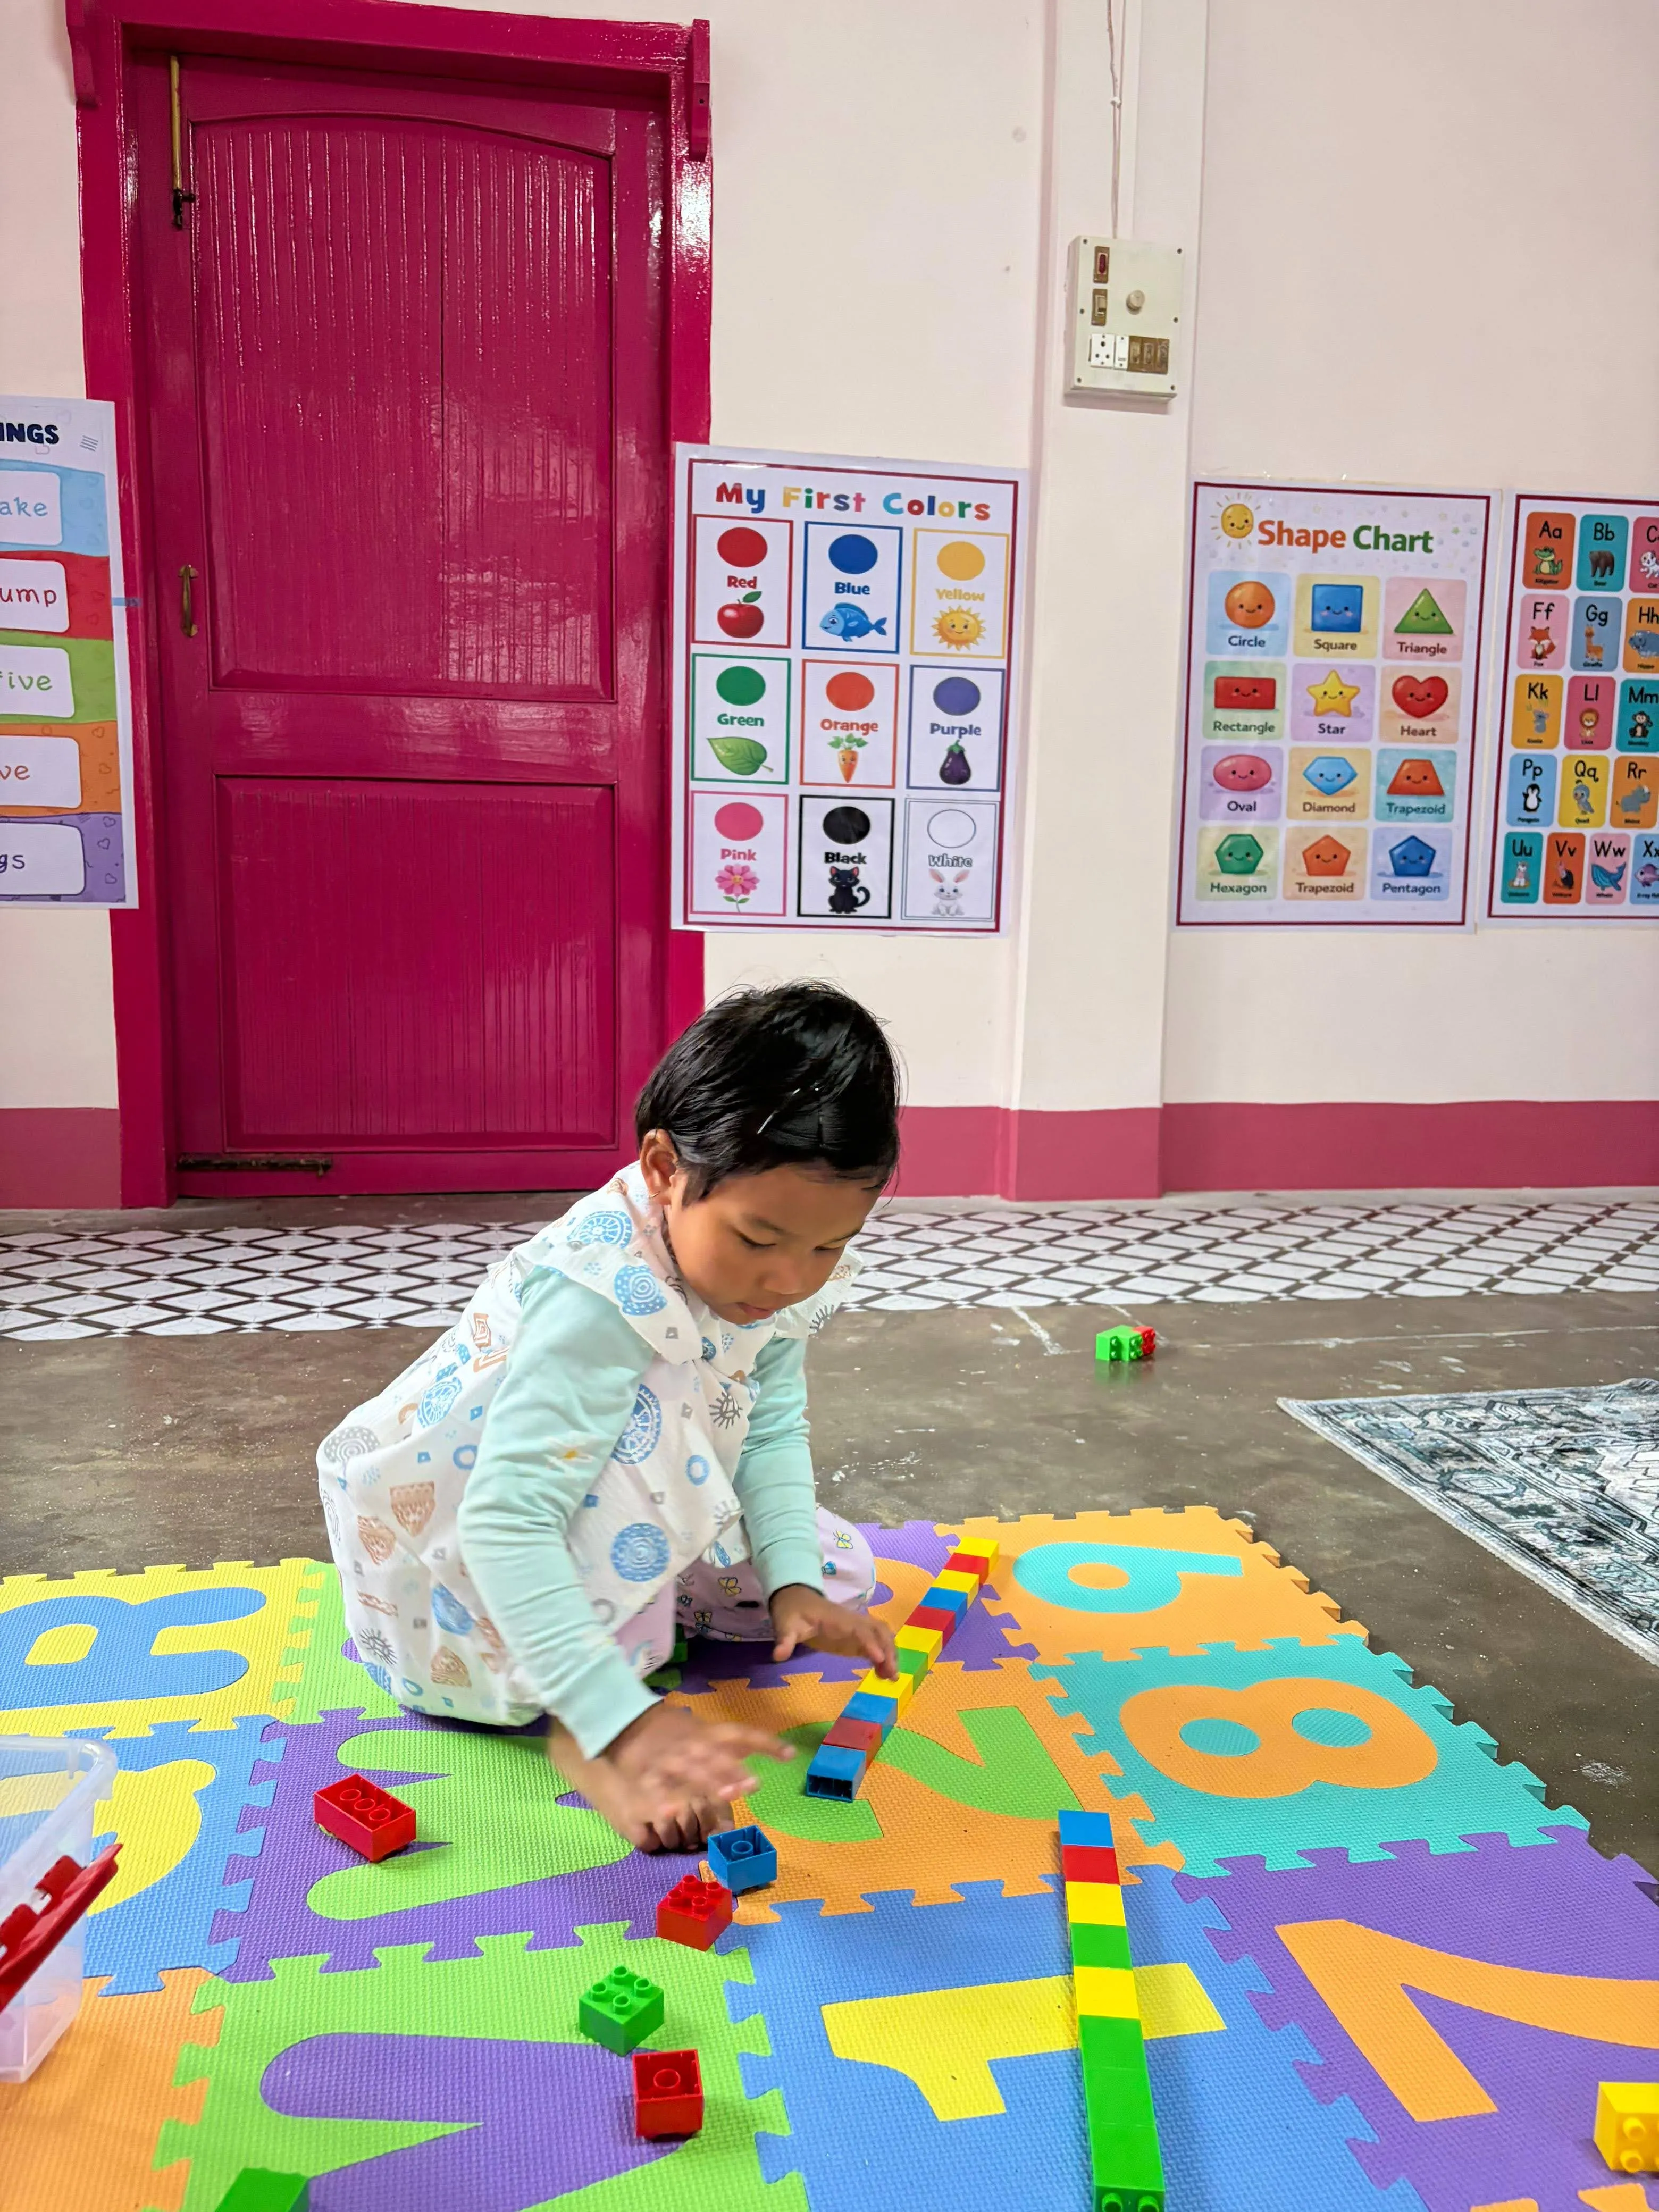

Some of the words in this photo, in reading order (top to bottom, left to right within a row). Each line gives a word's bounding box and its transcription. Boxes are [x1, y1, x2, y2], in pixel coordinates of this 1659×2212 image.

[0, 423, 59, 445] INGS
[0, 497, 48, 517] ake
[716, 482, 766, 514] My
[782, 486, 867, 512] First
[883, 492, 991, 521] Colors
[1257, 520, 1346, 554] Shape
[1353, 525, 1434, 554] Chart
[1538, 521, 1562, 539] Aa
[1593, 522, 1615, 541] Bb
[1646, 525, 1659, 543] C
[726, 575, 758, 590] Red
[834, 581, 870, 596] Blue
[935, 588, 985, 602] Yellow
[1532, 601, 1555, 620] Ff
[1585, 604, 1608, 627] Gg
[1228, 635, 1266, 648] Circle
[1313, 639, 1358, 652] Square
[1396, 642, 1447, 657] Triangle
[1527, 682, 1548, 700] Kk
[1583, 684, 1599, 701] Ll
[1628, 686, 1659, 704] Mm
[716, 713, 765, 728] Green
[819, 718, 879, 736] Orange
[1213, 720, 1276, 735] Rectangle
[1317, 723, 1346, 735] Star
[929, 723, 982, 739] Purple
[1400, 725, 1437, 737] Heart
[1522, 758, 1543, 781] Pp
[1574, 760, 1599, 782] Qq
[1627, 761, 1647, 780] Rr
[1226, 801, 1257, 813] Oval
[1302, 802, 1356, 814] Diamond
[1386, 802, 1446, 817] Trapezoid
[720, 848, 757, 862] Pink
[1512, 839, 1533, 857] Uu
[1555, 840, 1577, 856] Vv
[1594, 840, 1626, 858] Ww
[823, 852, 867, 866] Black
[928, 854, 973, 868] White
[1210, 882, 1267, 896] Hexagon
[1296, 882, 1354, 896] Trapezoid
[1382, 883, 1441, 896] Pentagon
[0, 1587, 266, 1711] R
[1120, 1677, 1438, 1798] 8
[744, 1705, 1082, 1841] 2
[1276, 1919, 1659, 2122] 7
[820, 1962, 1227, 2122] 1
